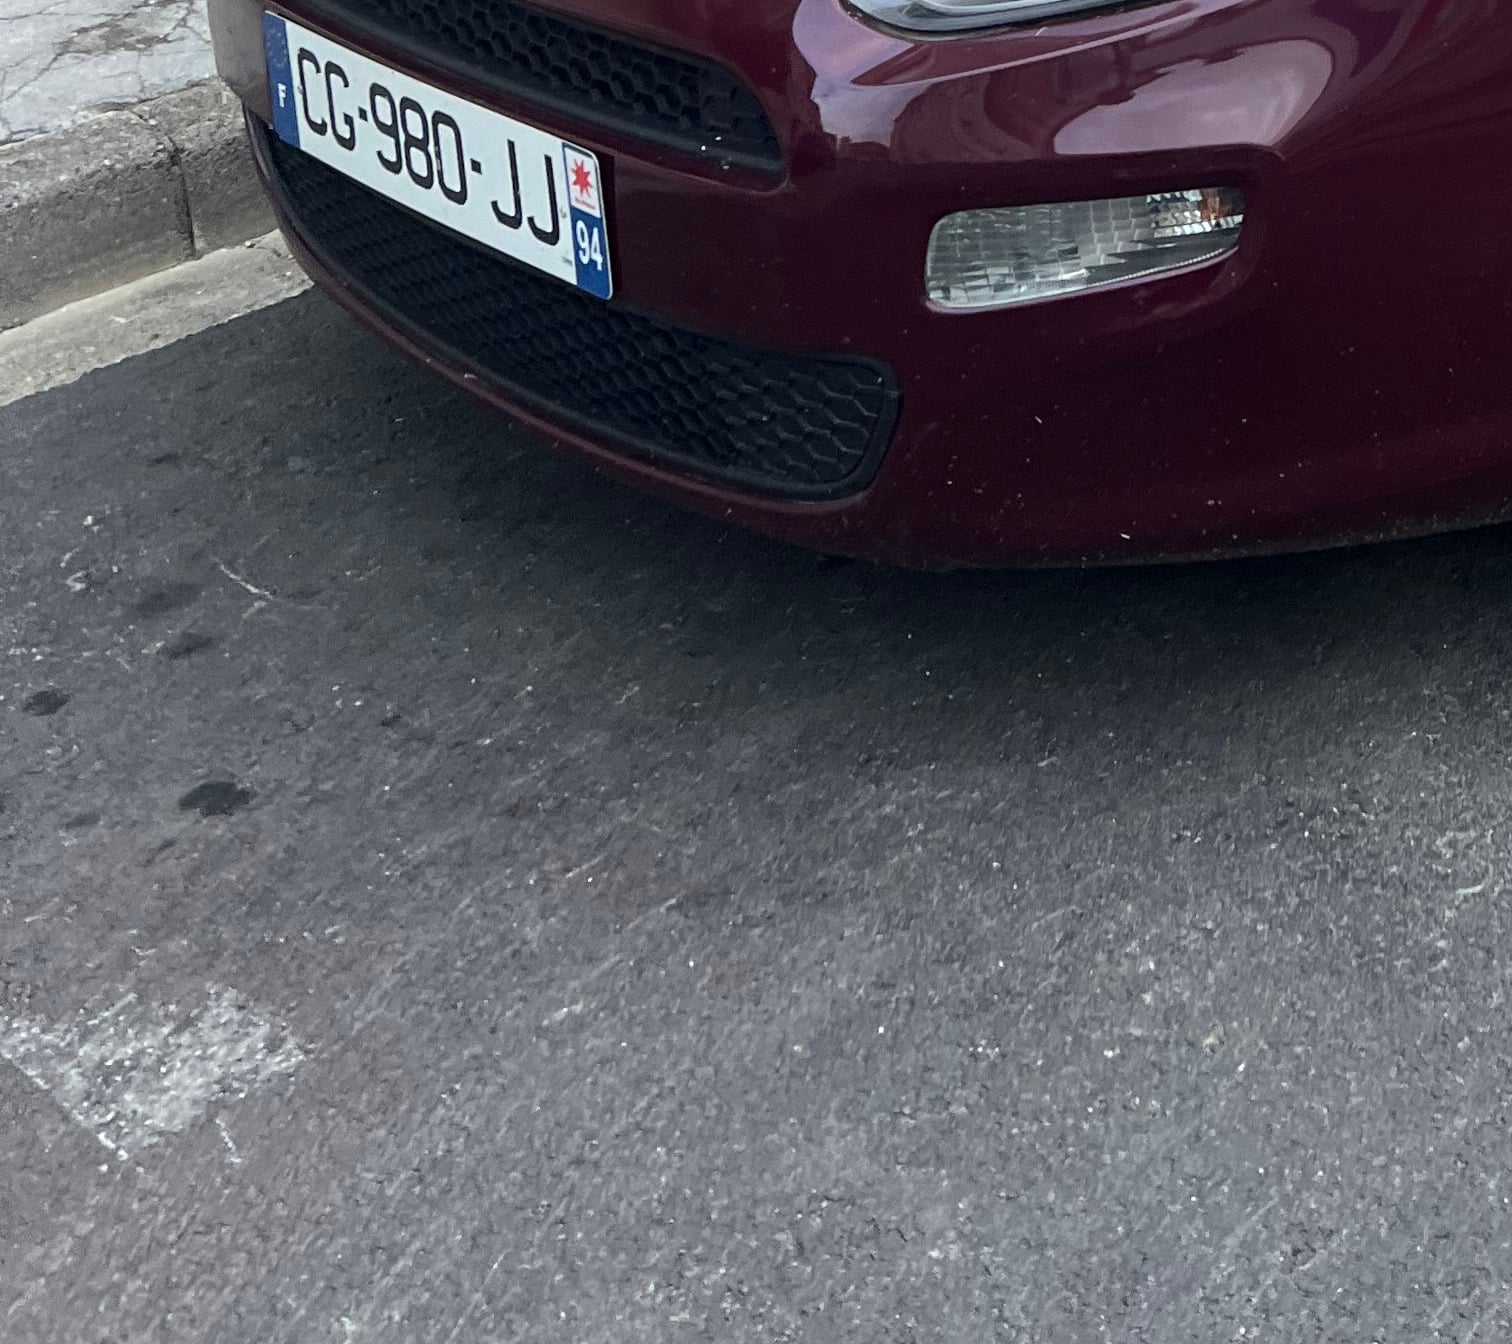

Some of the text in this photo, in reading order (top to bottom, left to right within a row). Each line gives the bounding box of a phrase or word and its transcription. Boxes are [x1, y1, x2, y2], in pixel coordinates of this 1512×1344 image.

[277, 82, 288, 108] F
[296, 46, 561, 247] CG-980-JJ
[575, 220, 604, 272] 94
